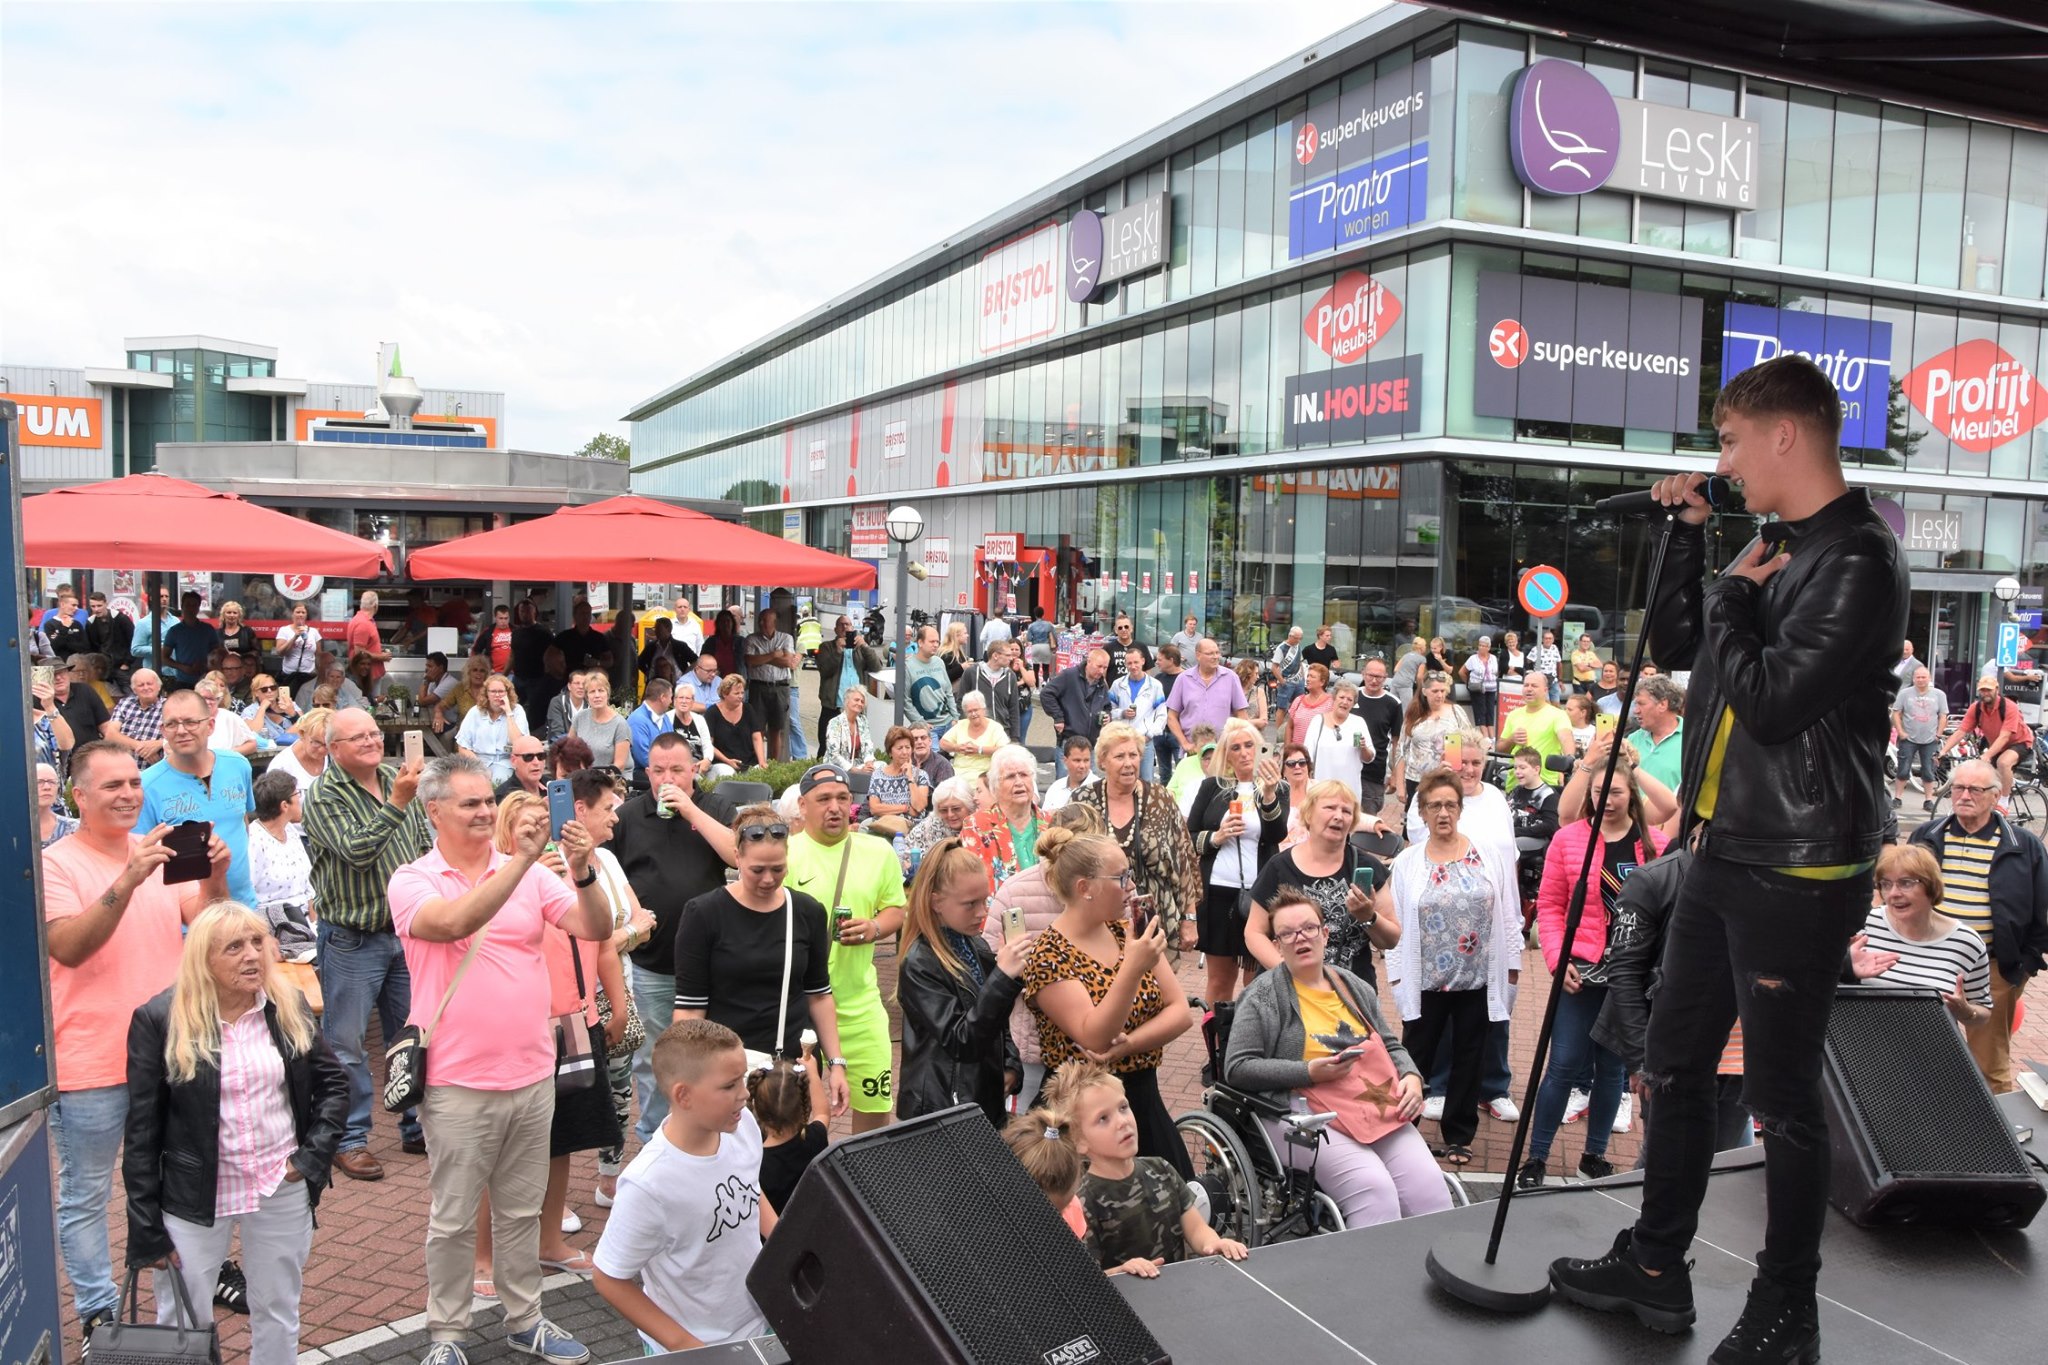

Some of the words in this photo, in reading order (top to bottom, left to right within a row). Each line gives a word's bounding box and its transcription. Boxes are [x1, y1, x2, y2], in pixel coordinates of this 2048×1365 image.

[1320, 92, 1424, 150] superkeukens
[1642, 107, 1752, 182] Leski
[1318, 169, 1392, 224] Pronto
[1640, 168, 1750, 202] LIVING
[1111, 199, 1160, 260] Leski
[1344, 210, 1390, 238] wonen
[1110, 245, 1158, 276] LIVING
[1317, 279, 1384, 350] Profijt
[1332, 321, 1377, 358] Meubel
[1533, 341, 1690, 376] superkeukens
[1754, 336, 1865, 392] Pnto
[1293, 378, 1410, 425] IN.HOUSE
[1925, 360, 2032, 424] Profijt
[1950, 411, 2020, 441] Meubel
[856, 511, 865, 527] TE
[866, 509, 888, 527] HUUR
[1911, 512, 1959, 540] Leski
[925, 550, 949, 565] BRISTOL
[986, 539, 1015, 558] BRISTOL
[1911, 540, 1958, 550] LIVING
[2003, 627, 2015, 648] P
